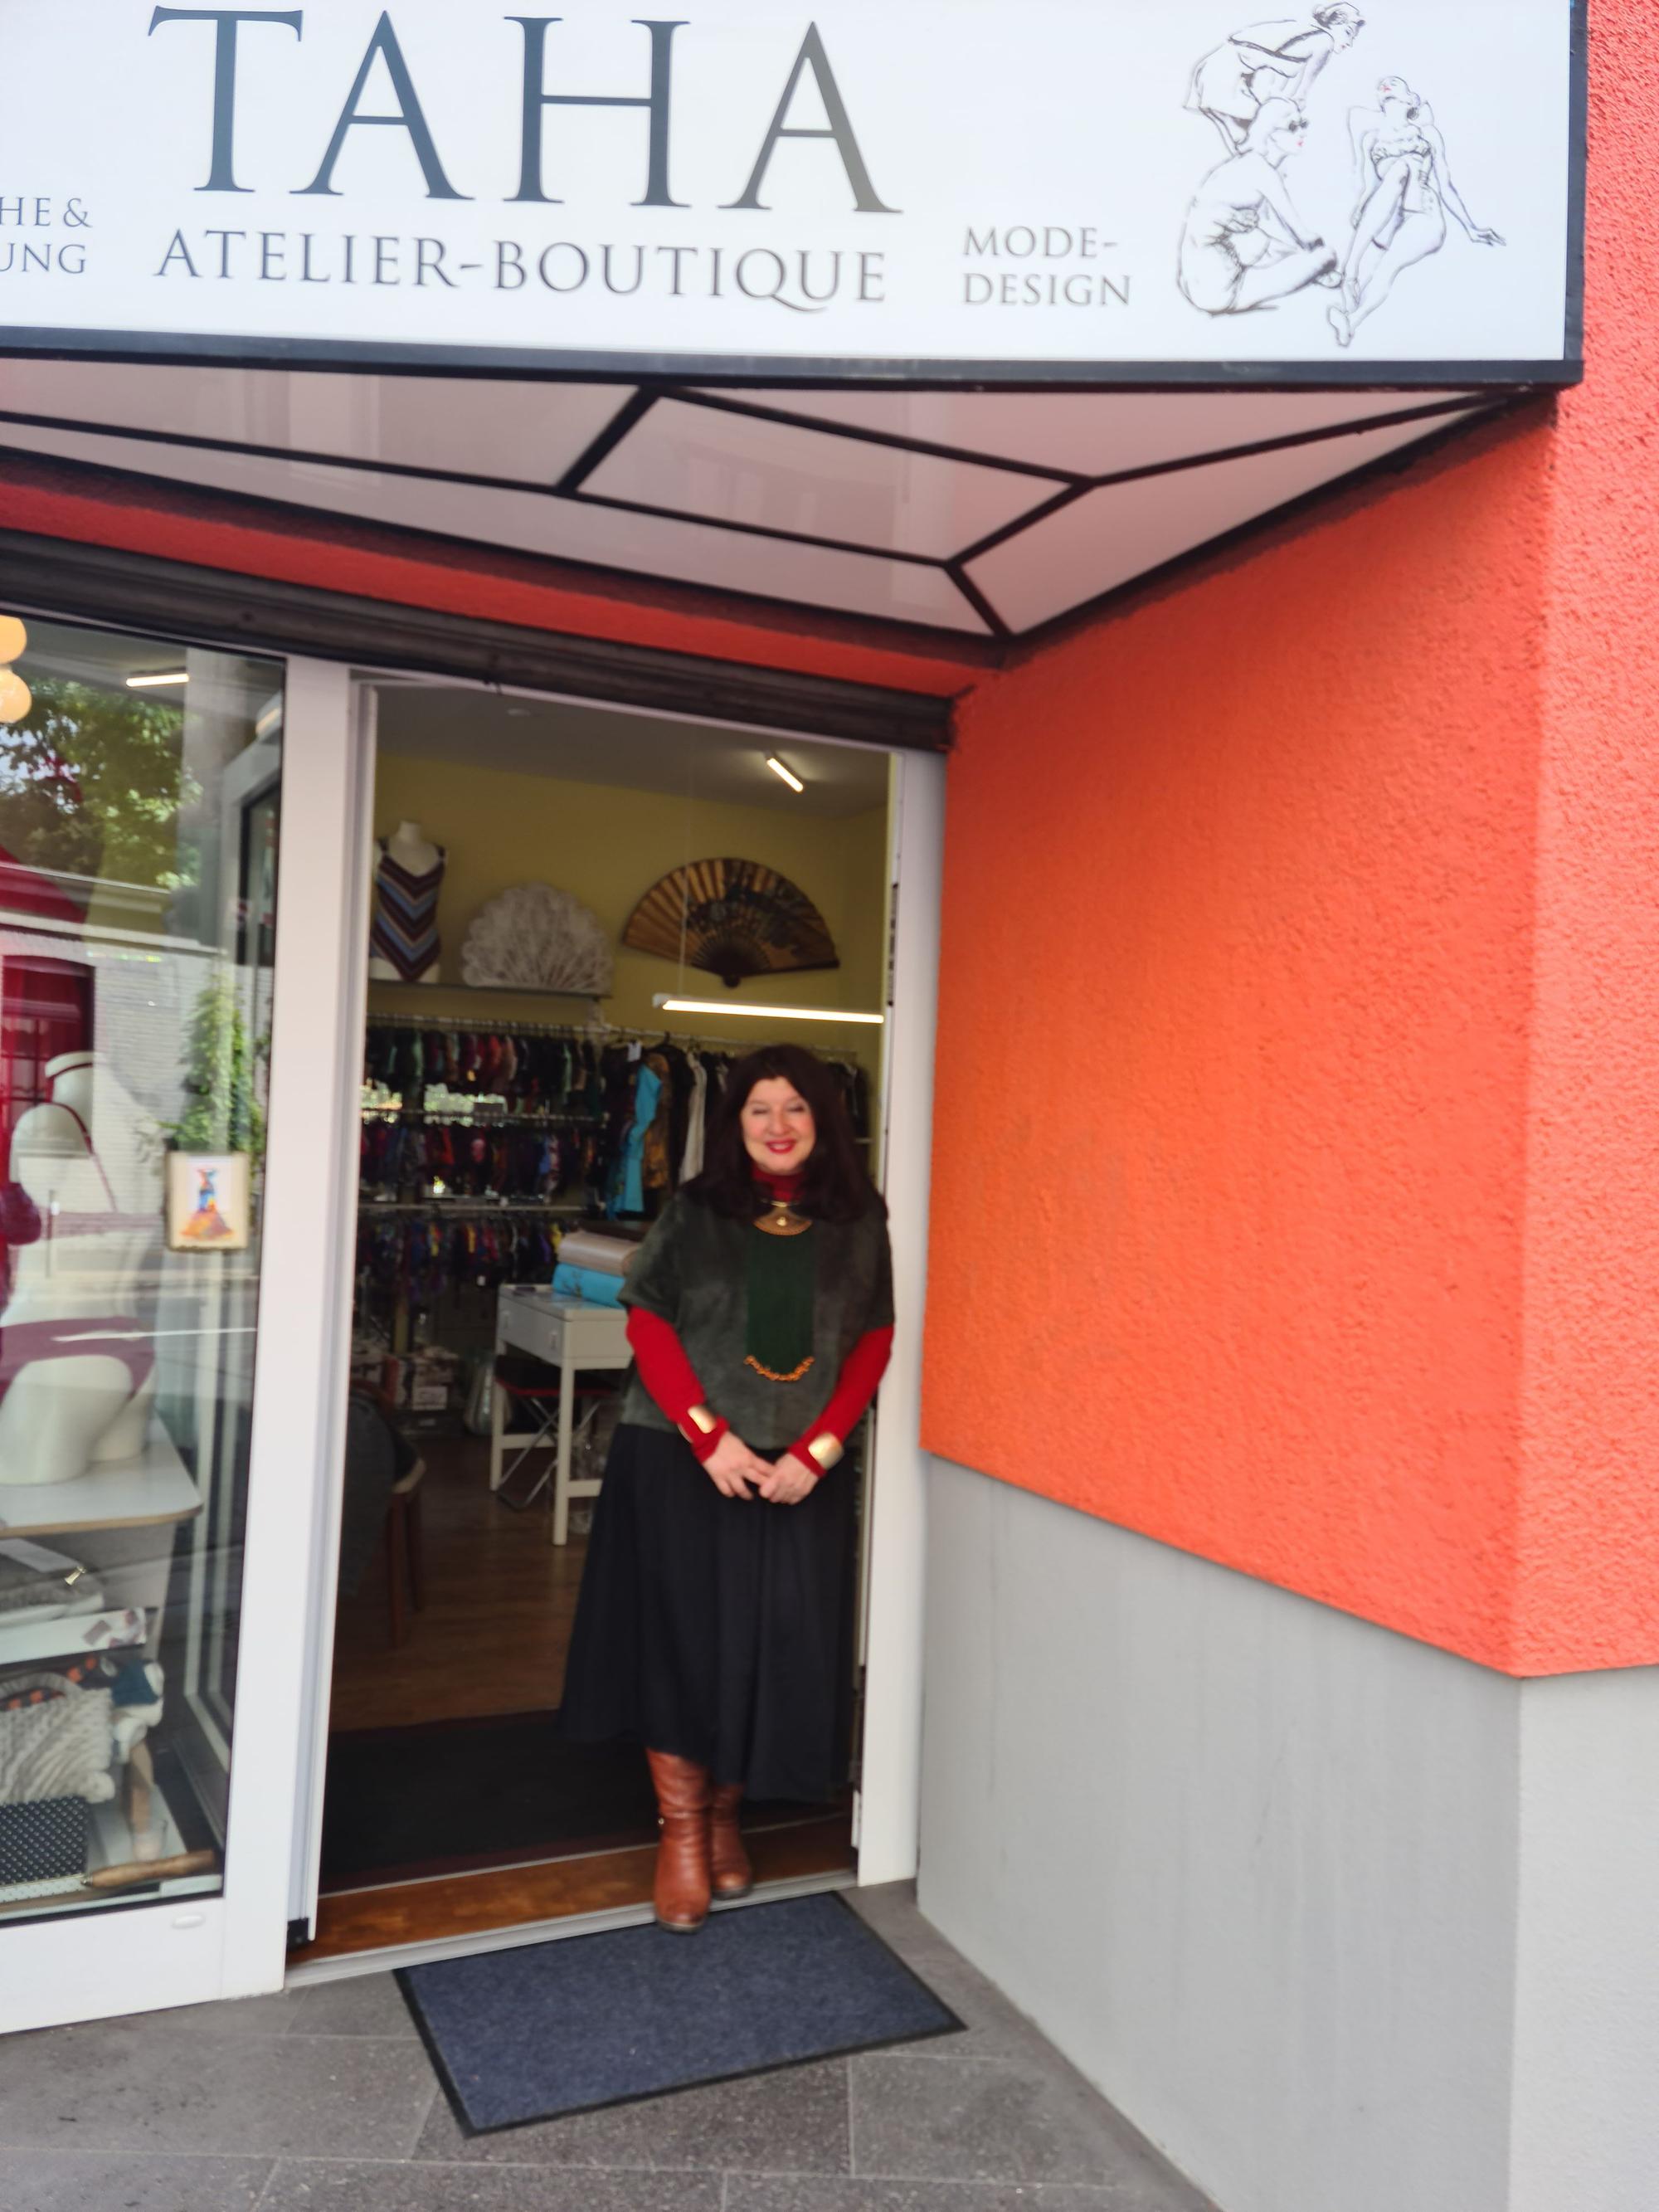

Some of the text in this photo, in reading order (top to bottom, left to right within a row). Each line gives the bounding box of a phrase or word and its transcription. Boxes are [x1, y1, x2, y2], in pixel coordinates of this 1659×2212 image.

[147, 4, 902, 214] TAHA
[153, 228, 886, 313] ATELIER-BOUTIQUE
[963, 226, 1118, 259] MODE-
[963, 272, 1131, 306] DESIGN
